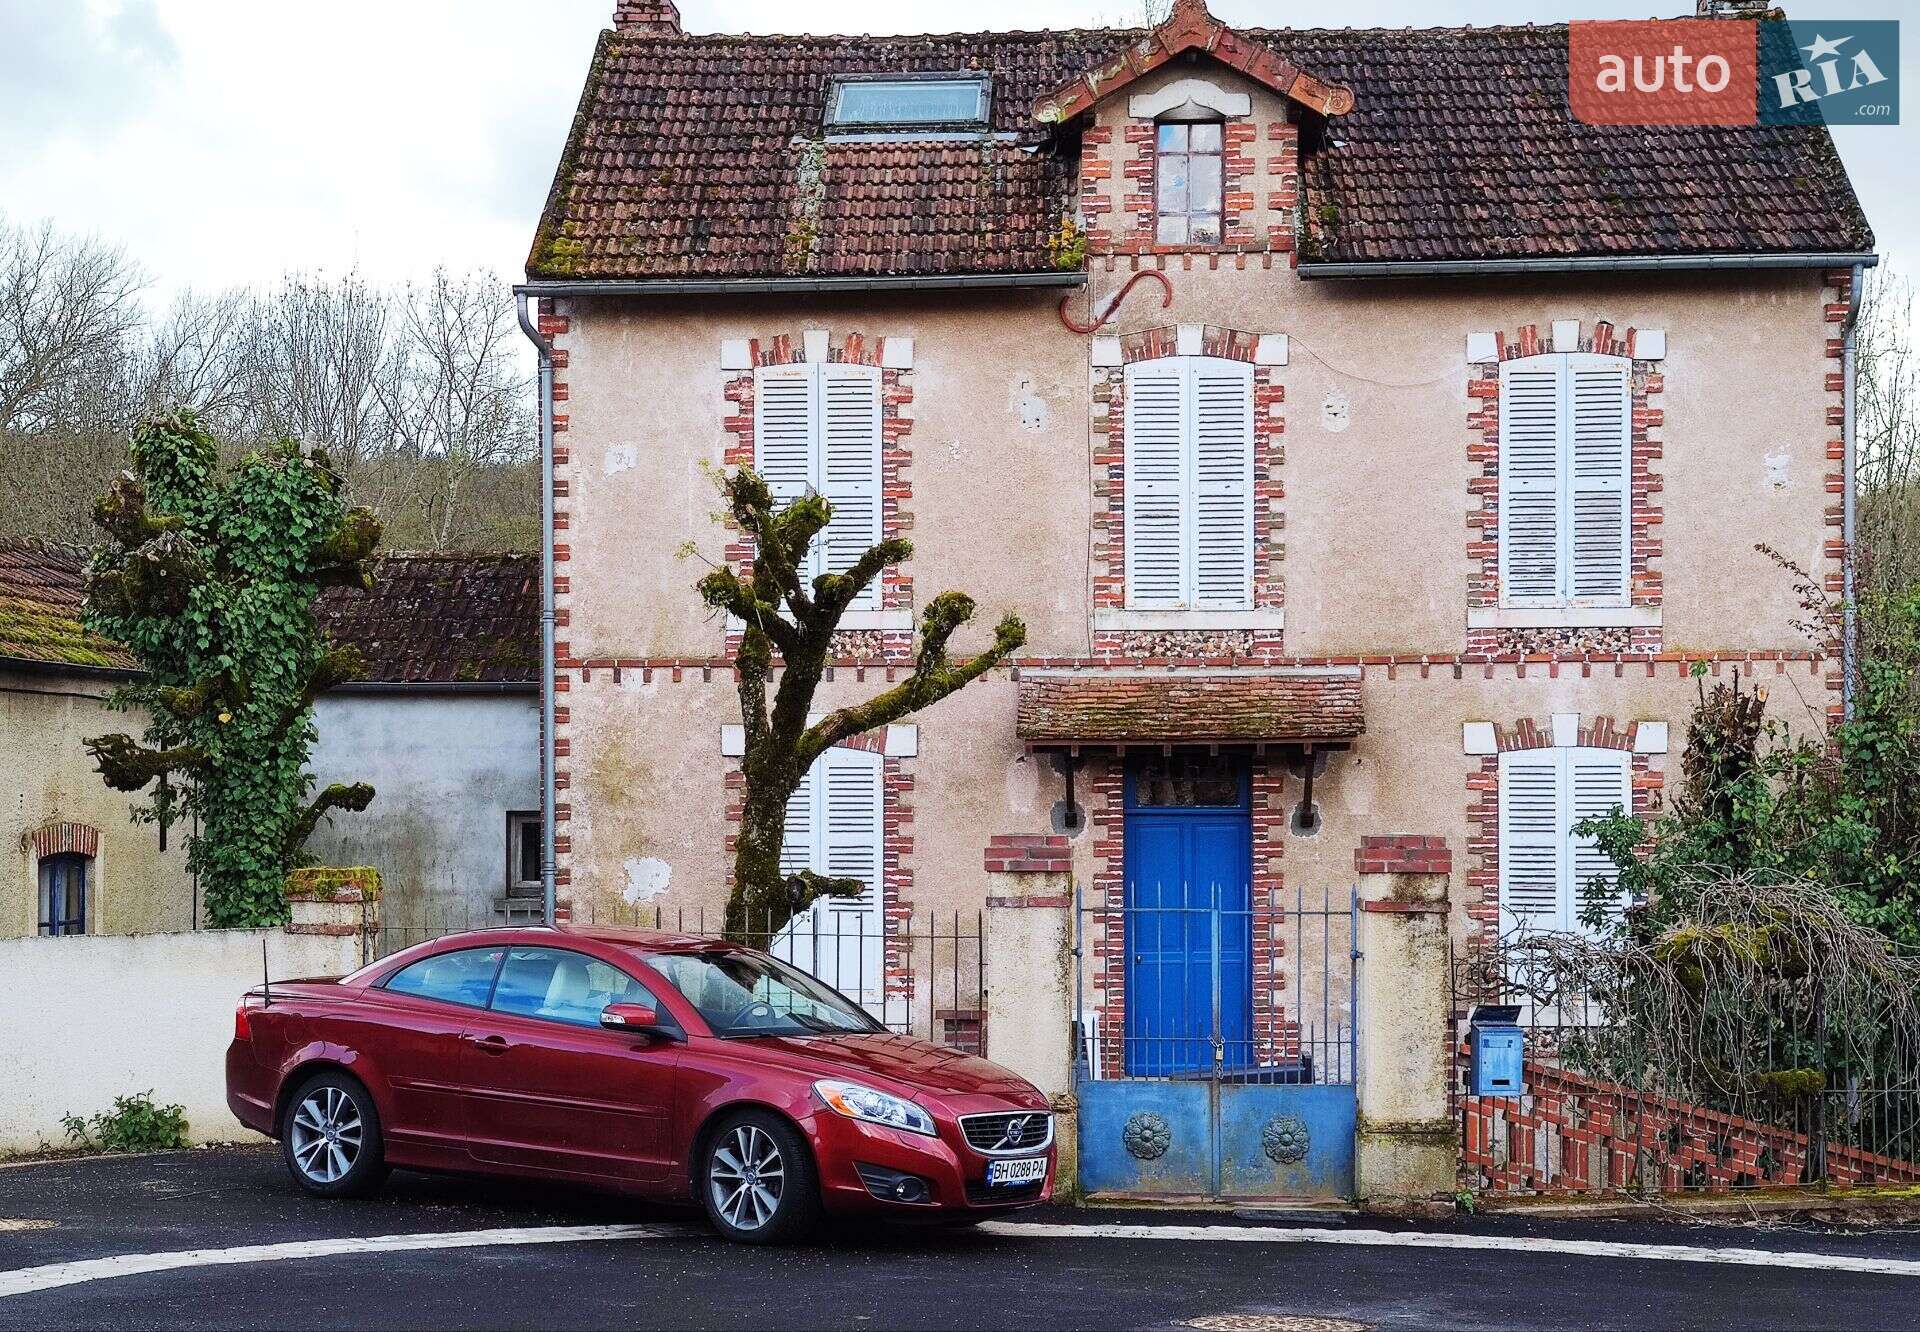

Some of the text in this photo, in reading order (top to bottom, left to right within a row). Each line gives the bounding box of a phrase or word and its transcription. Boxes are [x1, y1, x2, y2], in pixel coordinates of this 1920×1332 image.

[994, 1160, 1044, 1179] BH 0288 PA
